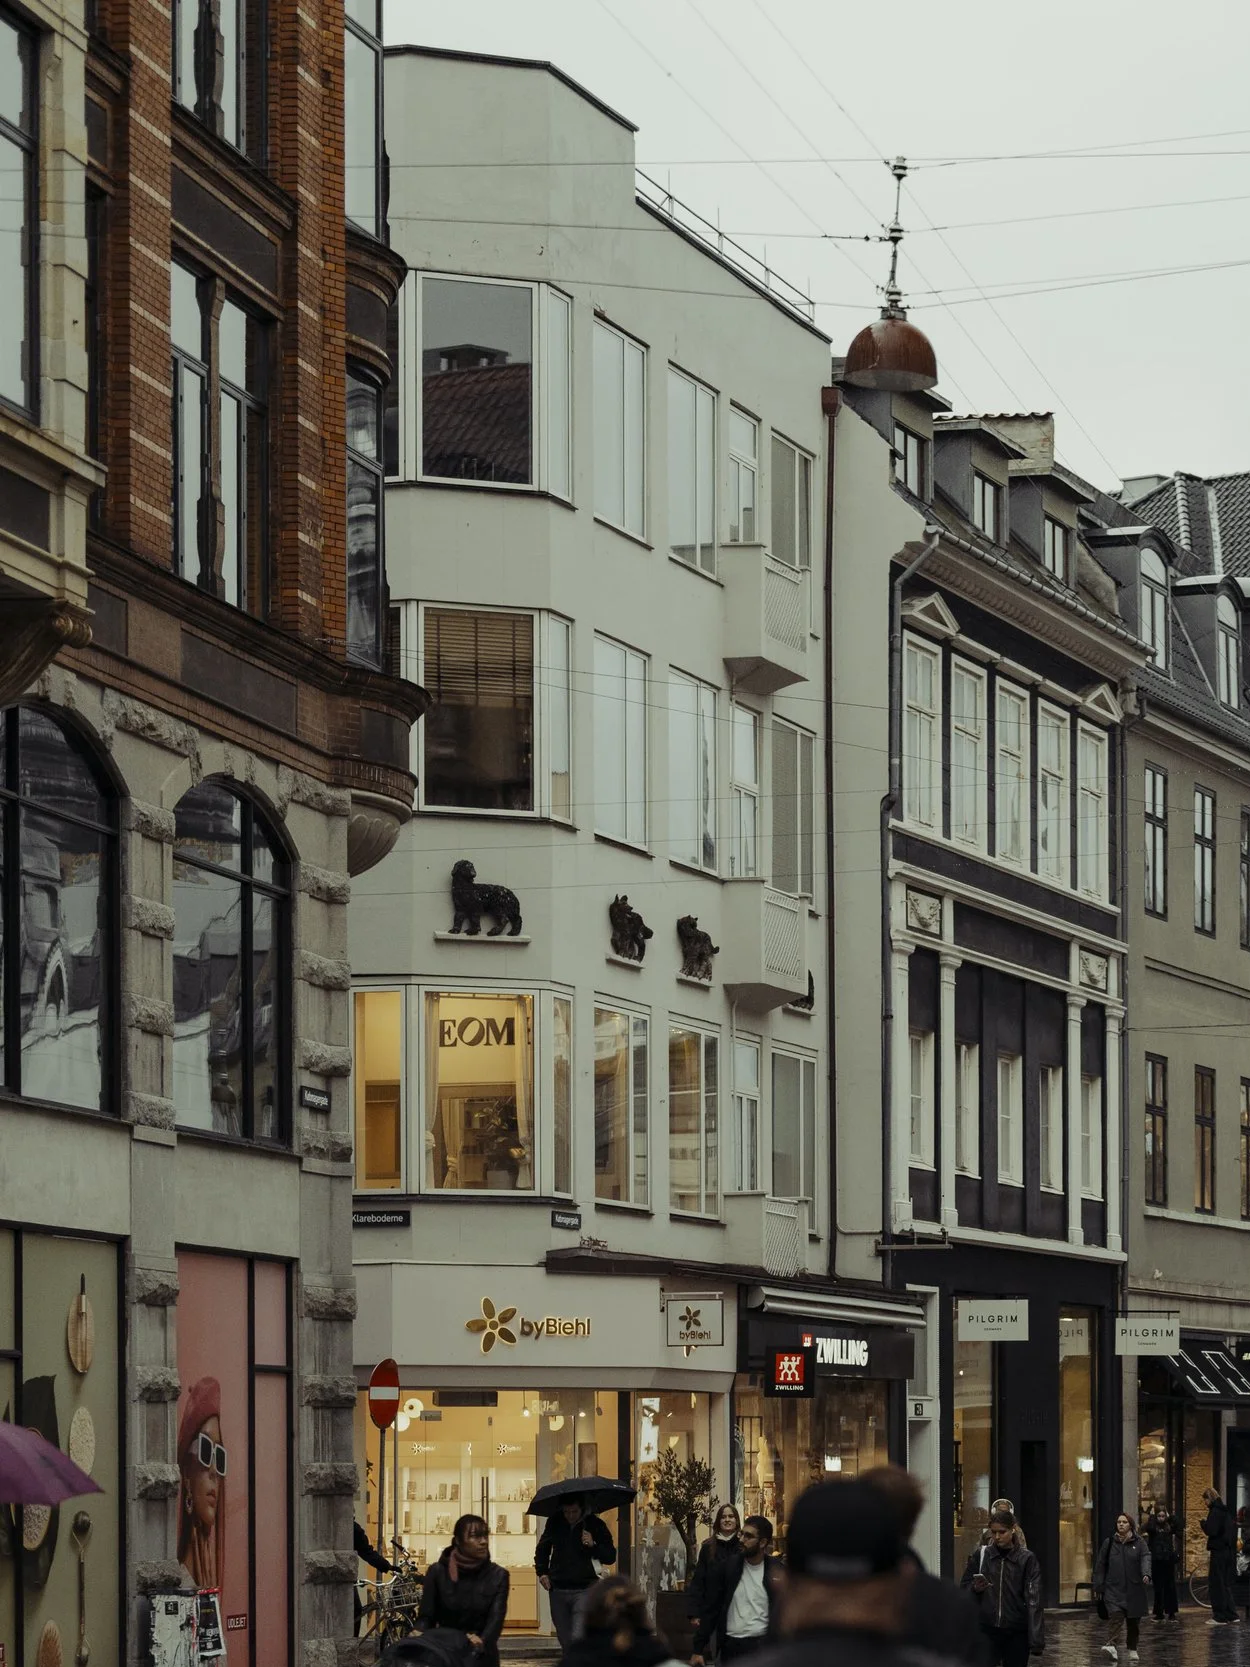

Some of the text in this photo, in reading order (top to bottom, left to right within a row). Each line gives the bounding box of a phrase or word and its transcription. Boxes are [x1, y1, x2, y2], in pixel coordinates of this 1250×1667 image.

[352, 1213, 404, 1223] Klareboderne
[968, 1314, 1018, 1324] PILGRIM
[519, 1316, 591, 1341] byBiehl
[1120, 1328, 1174, 1338] PILGRIM
[678, 1329, 712, 1341] byBiehl
[815, 1337, 869, 1367] ZWILLING
